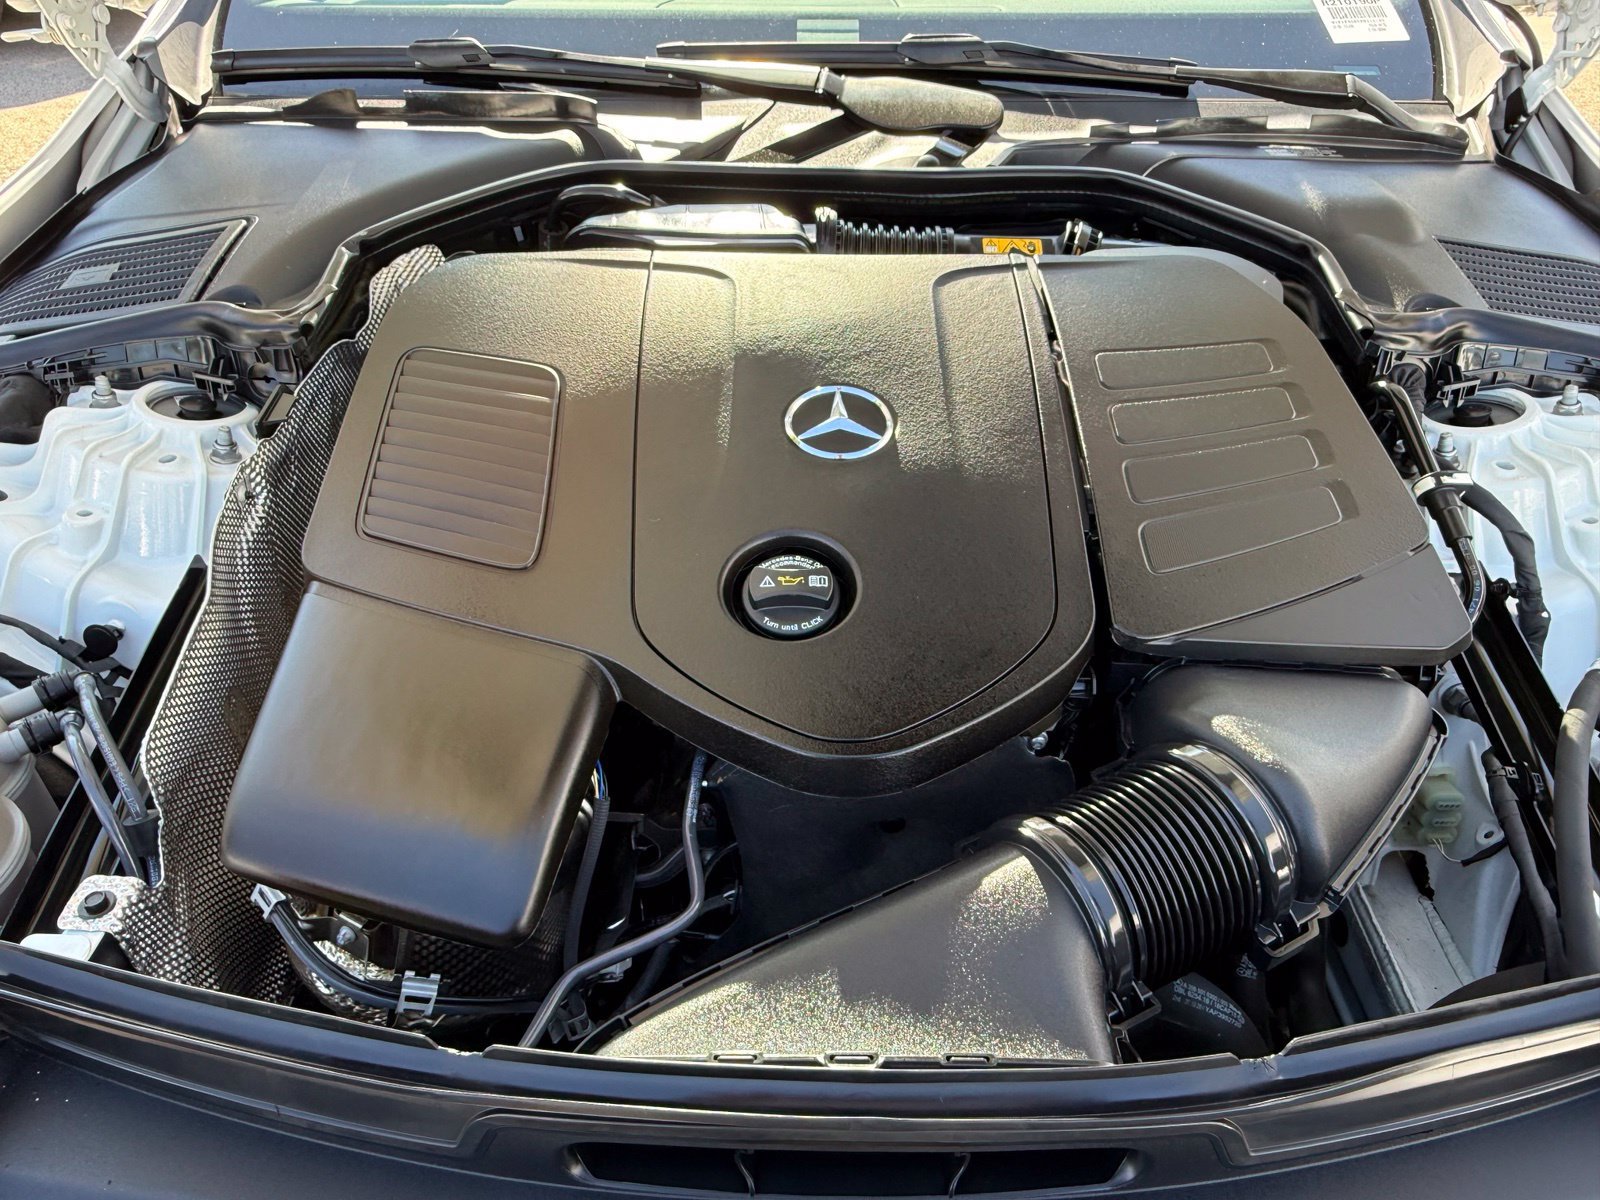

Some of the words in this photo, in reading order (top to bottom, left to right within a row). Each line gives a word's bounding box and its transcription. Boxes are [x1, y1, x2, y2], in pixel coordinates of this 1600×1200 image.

[763, 616, 779, 629] Turn
[781, 623, 799, 631] until
[801, 615, 824, 630] CLICK
